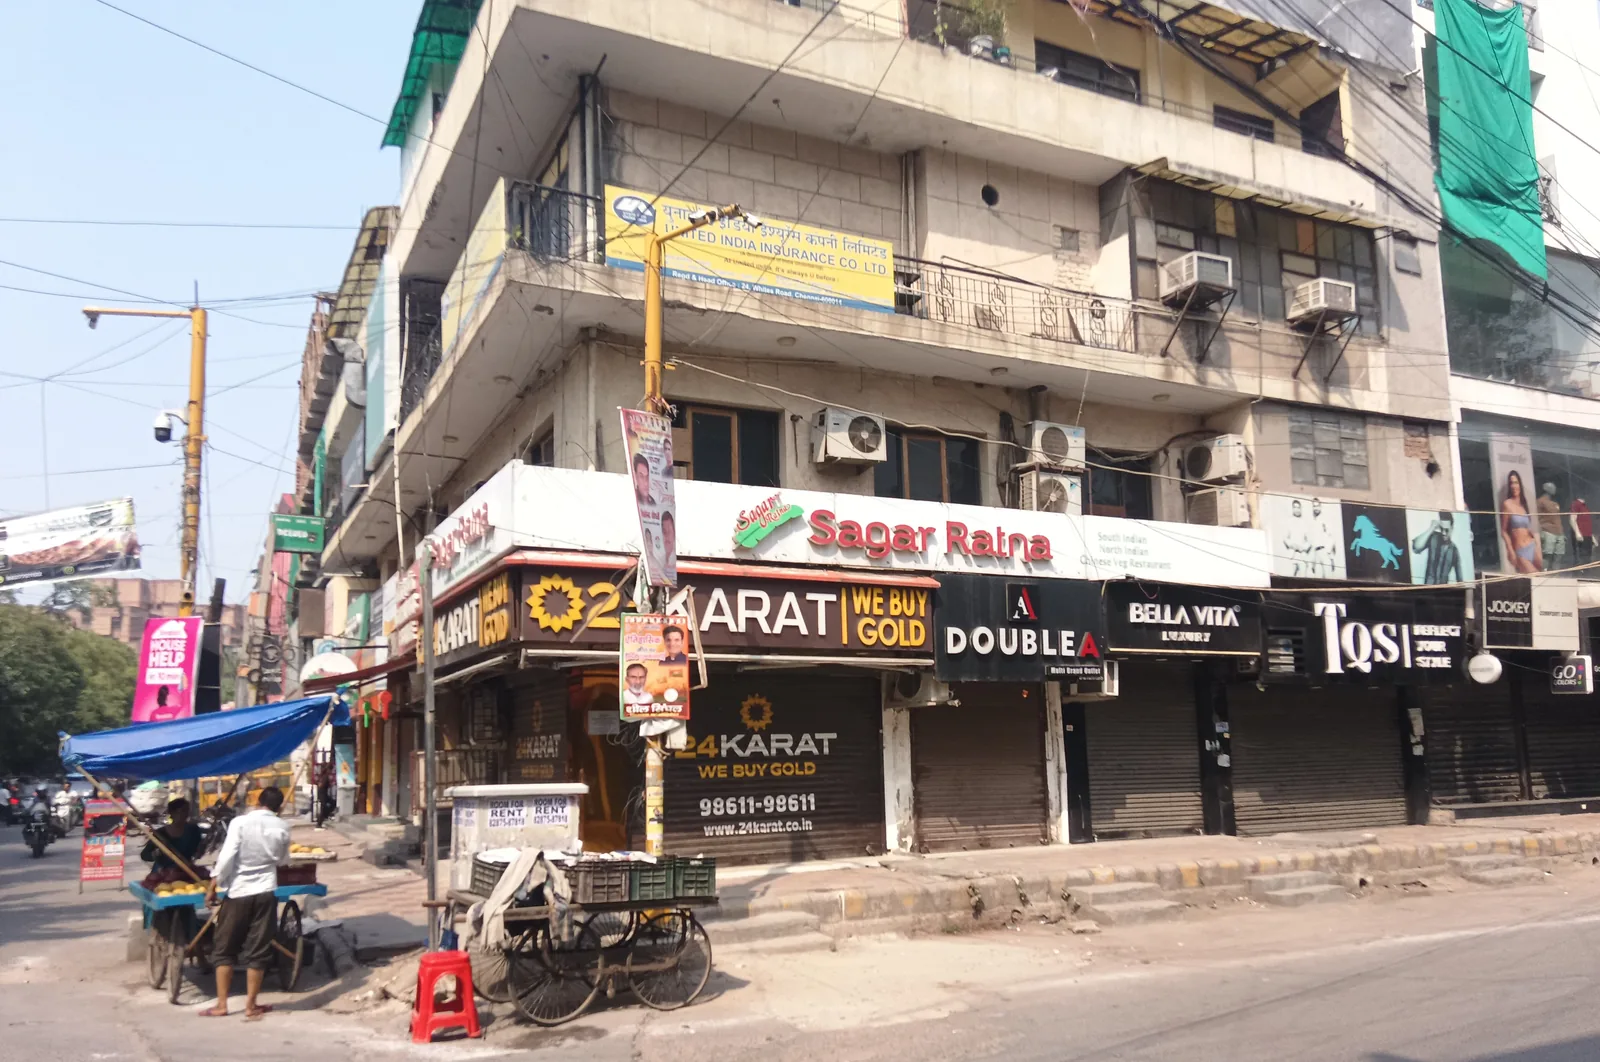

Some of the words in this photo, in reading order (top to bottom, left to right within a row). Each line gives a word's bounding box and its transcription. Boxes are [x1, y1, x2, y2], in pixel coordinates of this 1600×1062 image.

[721, 235, 757, 250] INDIA
[760, 242, 835, 266] INSURANCE
[737, 492, 781, 530] Sagar
[807, 508, 936, 558] Sagar
[944, 520, 1054, 563] Ratna
[1098, 532, 1122, 544] South
[1123, 533, 1148, 545] Indian
[1100, 544, 1123, 555] North
[1124, 545, 1149, 556] Indian
[852, 586, 884, 615] WE
[889, 588, 928, 617] BUY
[1487, 600, 1531, 614] JOCKEY
[857, 617, 926, 647] GOLD
[1161, 631, 1211, 642] LUXURY
[150, 639, 187, 652] HOUSE
[148, 651, 186, 667] HELP
[1553, 664, 1577, 680] GO
[698, 764, 728, 779] WE
[732, 763, 767, 778] BUY
[770, 761, 817, 777] GOLD
[490, 808, 524, 817] RENT
[535, 806, 567, 815] RENT
[700, 793, 816, 817] 98611-98611
[703, 817, 813, 837] www.24karat.co.in
